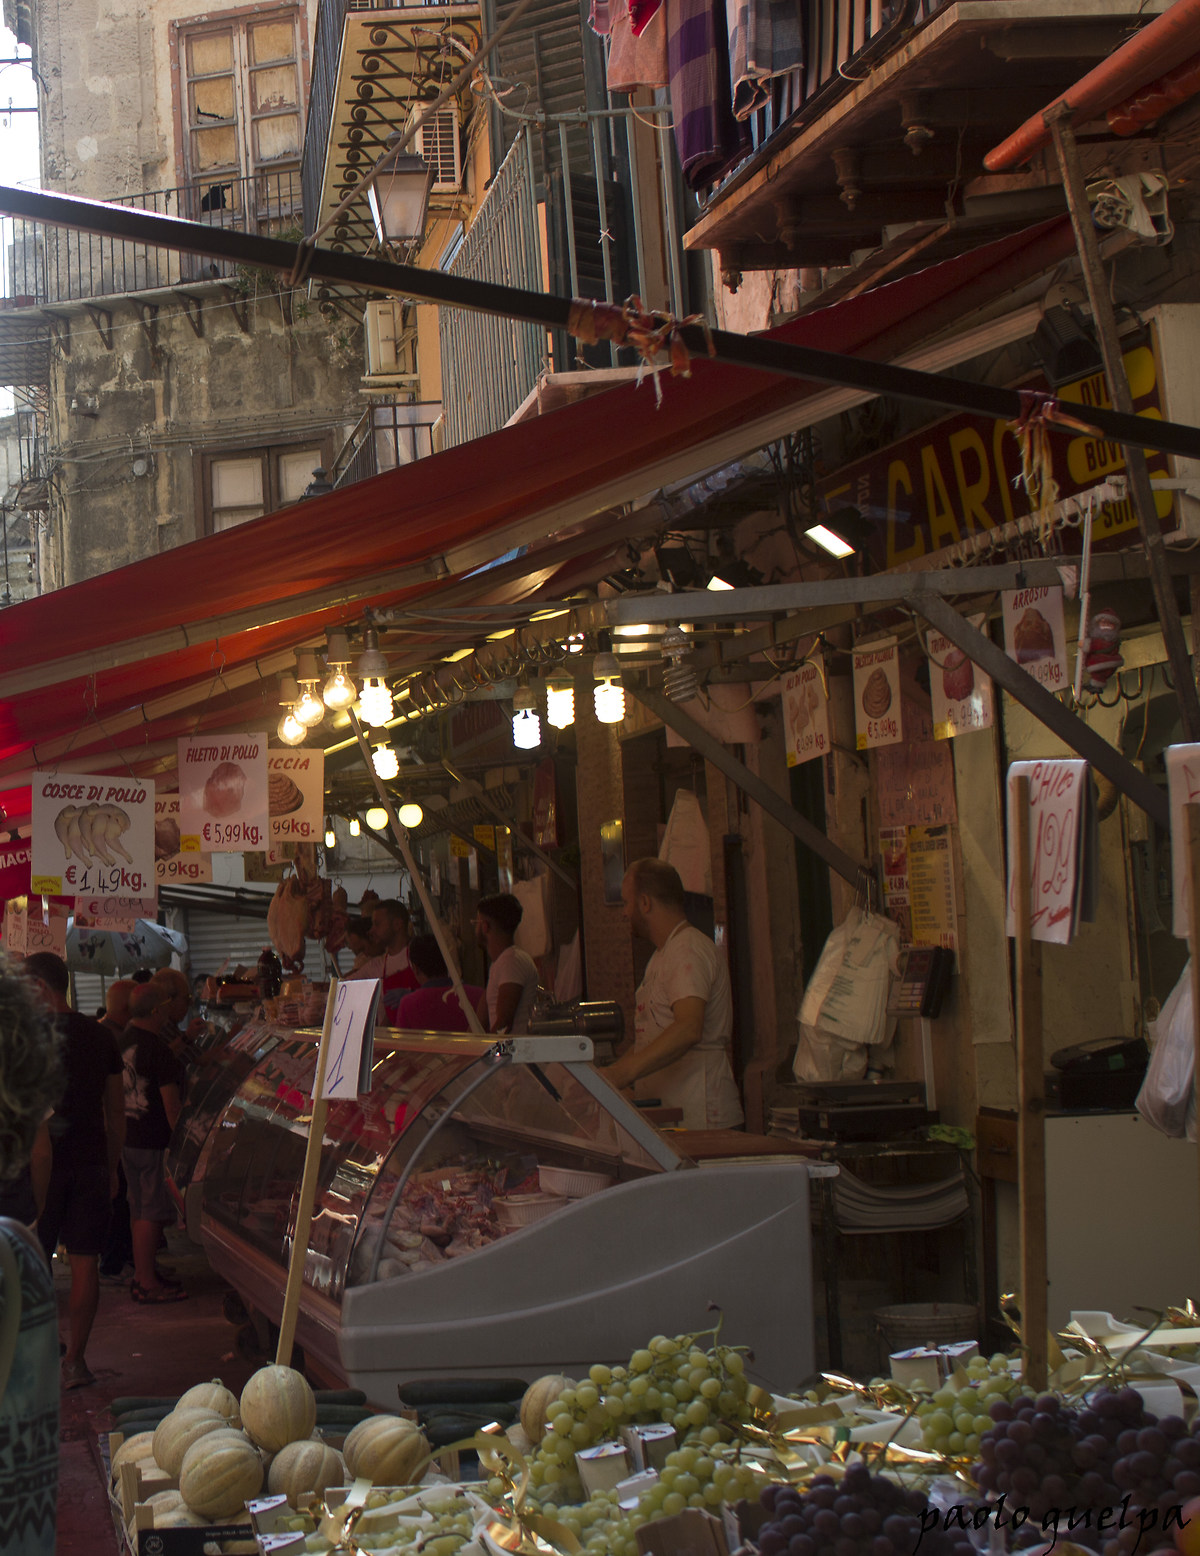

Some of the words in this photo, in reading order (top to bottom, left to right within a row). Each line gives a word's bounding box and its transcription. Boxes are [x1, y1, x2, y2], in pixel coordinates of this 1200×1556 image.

[1013, 587, 1049, 611] ARROSTO
[186, 748, 218, 763] FILETTO
[220, 746, 231, 761] DI
[232, 744, 259, 761] POLLO
[42, 783, 85, 800] COSCE
[87, 786, 103, 801] DI
[105, 787, 147, 803] POLLO
[203, 823, 211, 841] €
[65, 865, 77, 884] €
[89, 901, 99, 915] €
